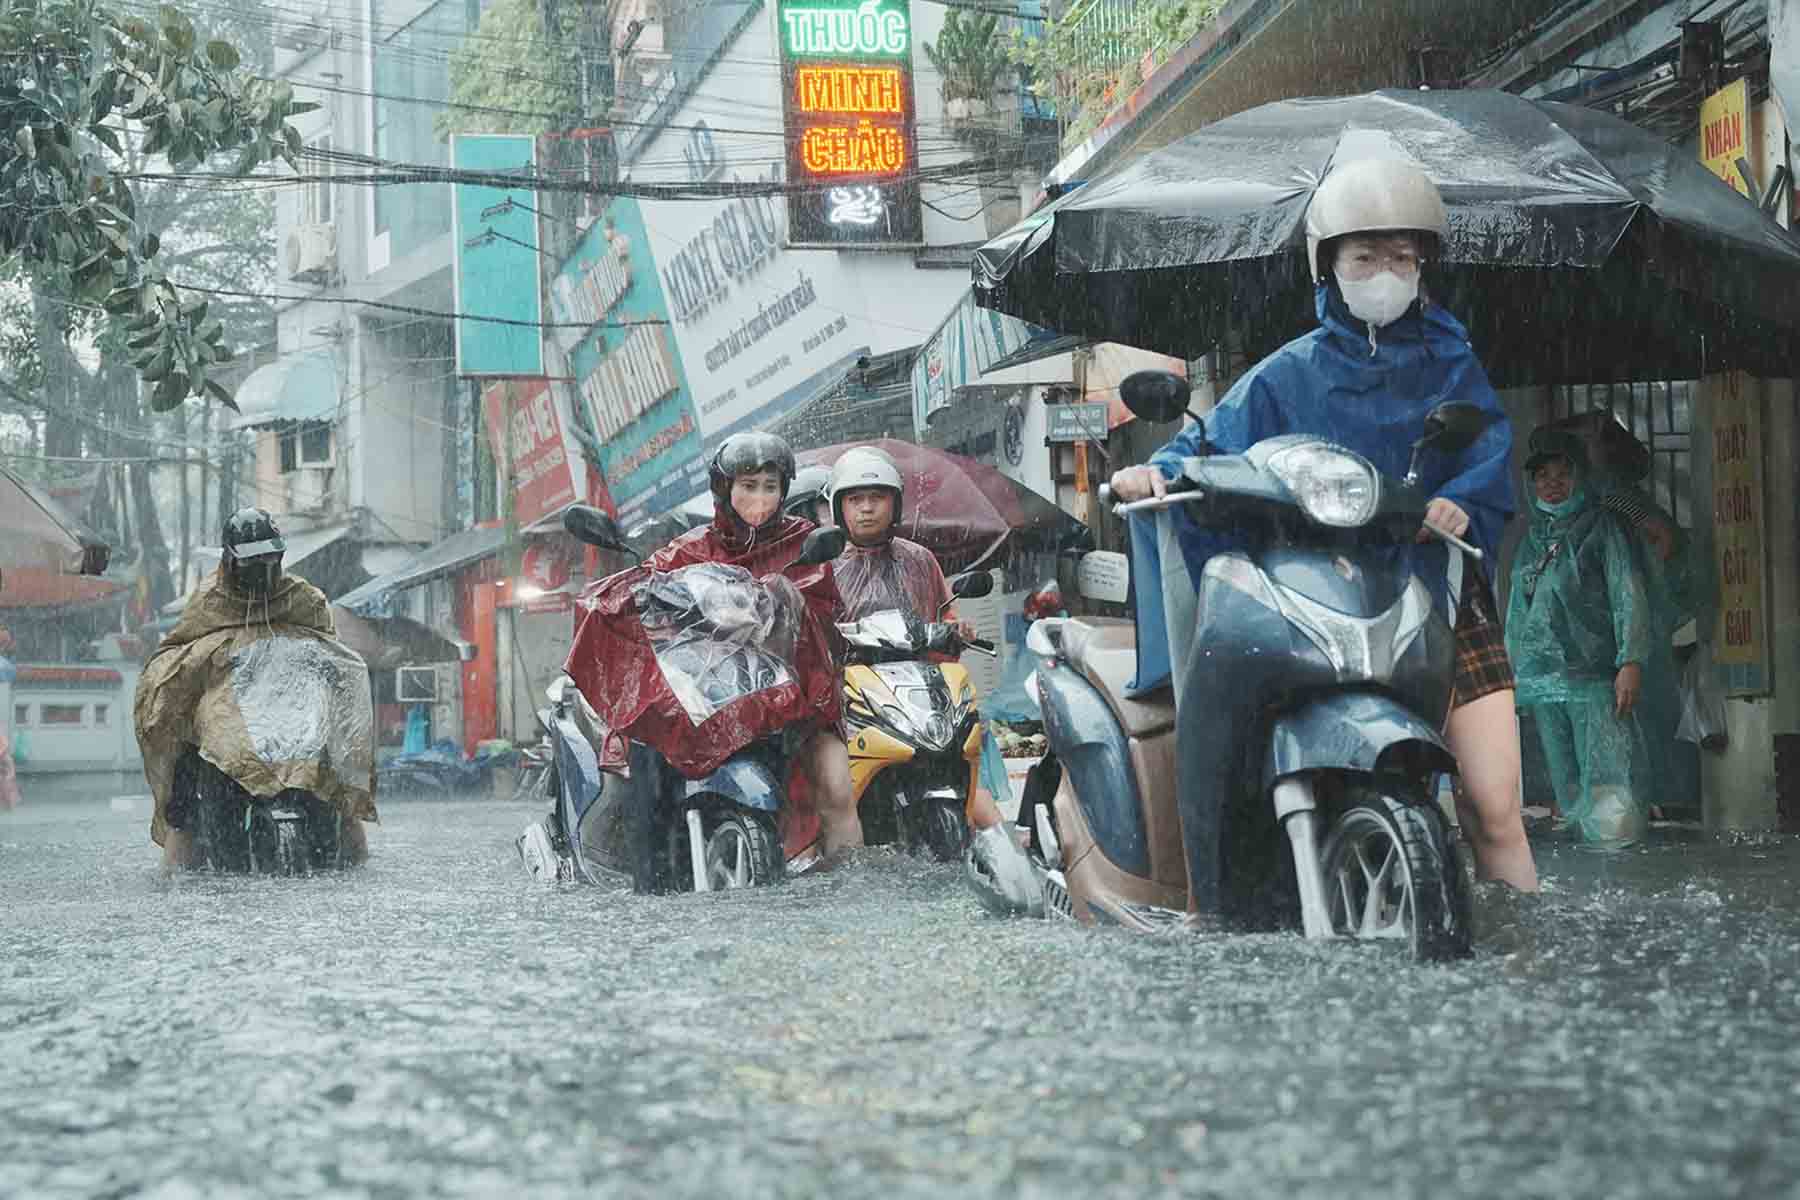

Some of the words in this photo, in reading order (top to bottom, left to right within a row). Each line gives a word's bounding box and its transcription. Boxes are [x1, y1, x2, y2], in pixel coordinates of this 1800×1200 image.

[783, 2, 907, 53] THUỐC
[799, 68, 901, 113] MINH
[803, 118, 905, 172] CHÂU
